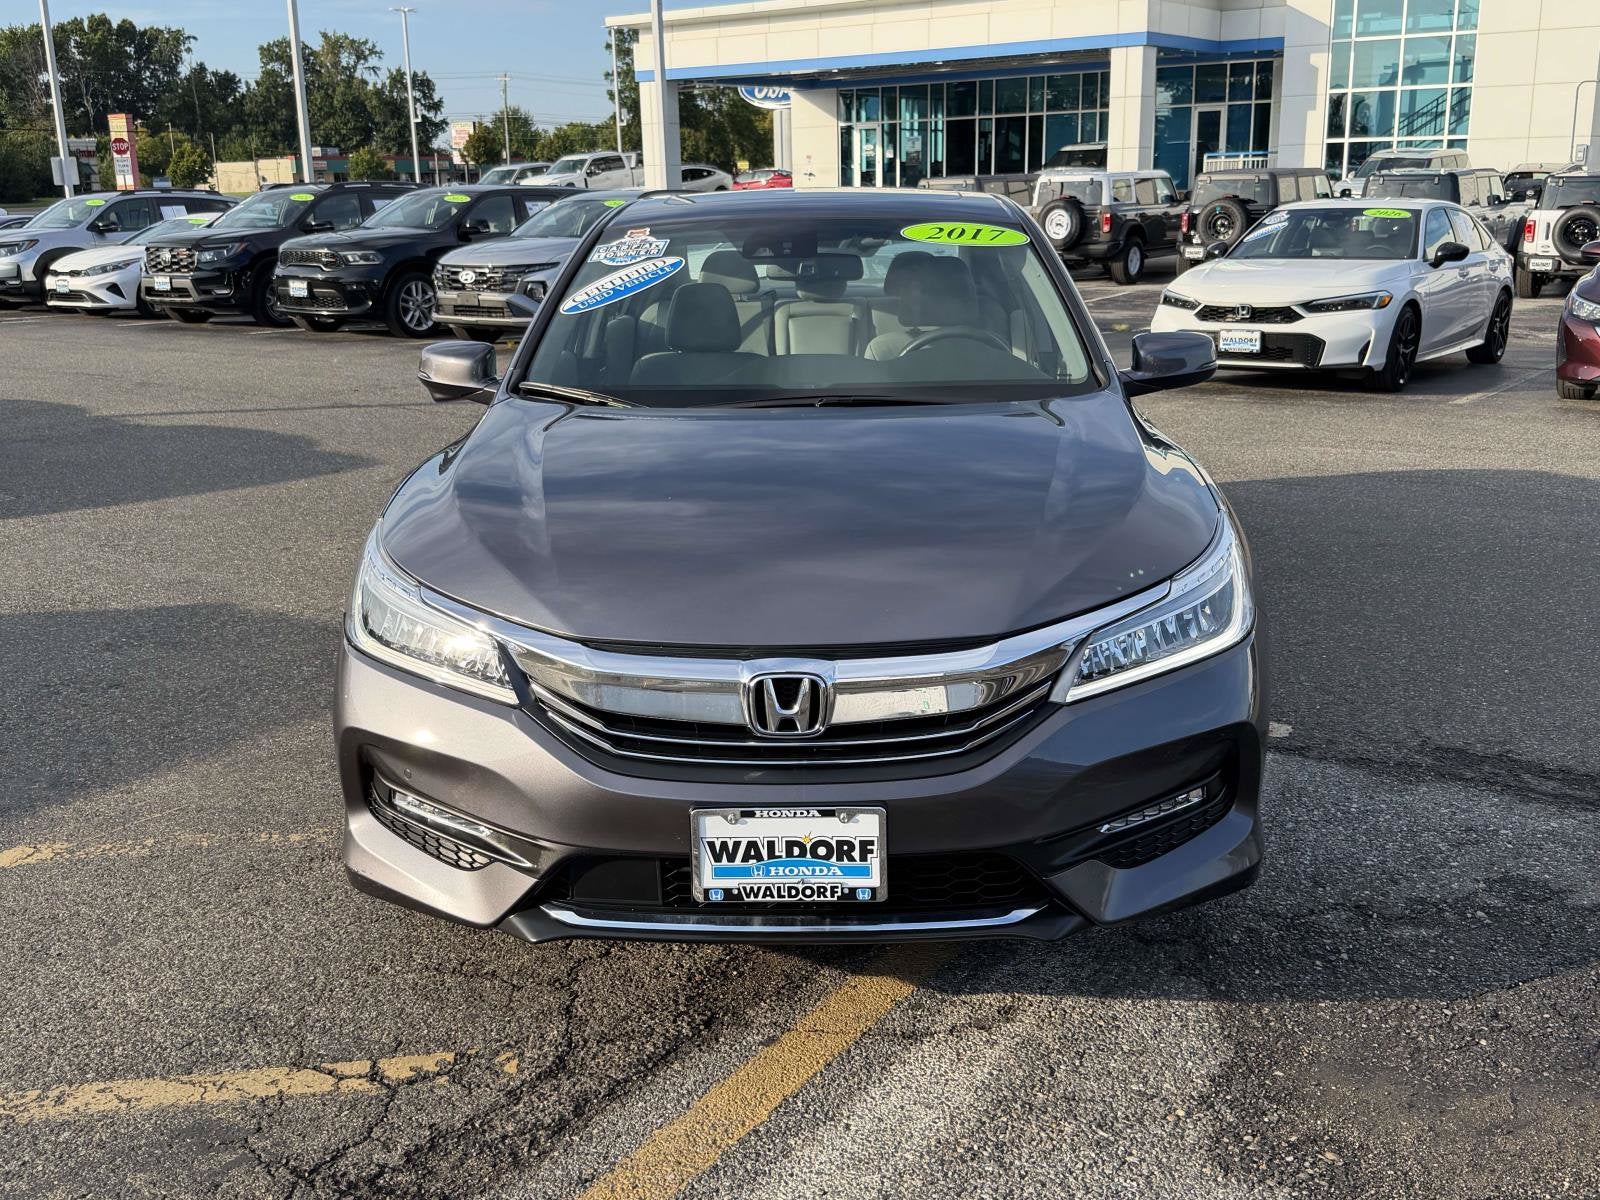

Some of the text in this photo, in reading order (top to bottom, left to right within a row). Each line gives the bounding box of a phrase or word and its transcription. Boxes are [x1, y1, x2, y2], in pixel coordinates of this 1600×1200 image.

[112, 143, 129, 151] STOP
[925, 226, 1006, 241] 2017
[598, 241, 661, 254] CARFAX
[572, 259, 668, 304] CERTIFIED
[577, 265, 675, 310] USED VEHICLE
[754, 809, 822, 818] HONDA
[705, 838, 877, 864] WALDORF
[768, 865, 844, 877] HONDA
[740, 884, 841, 900] WALDORF
